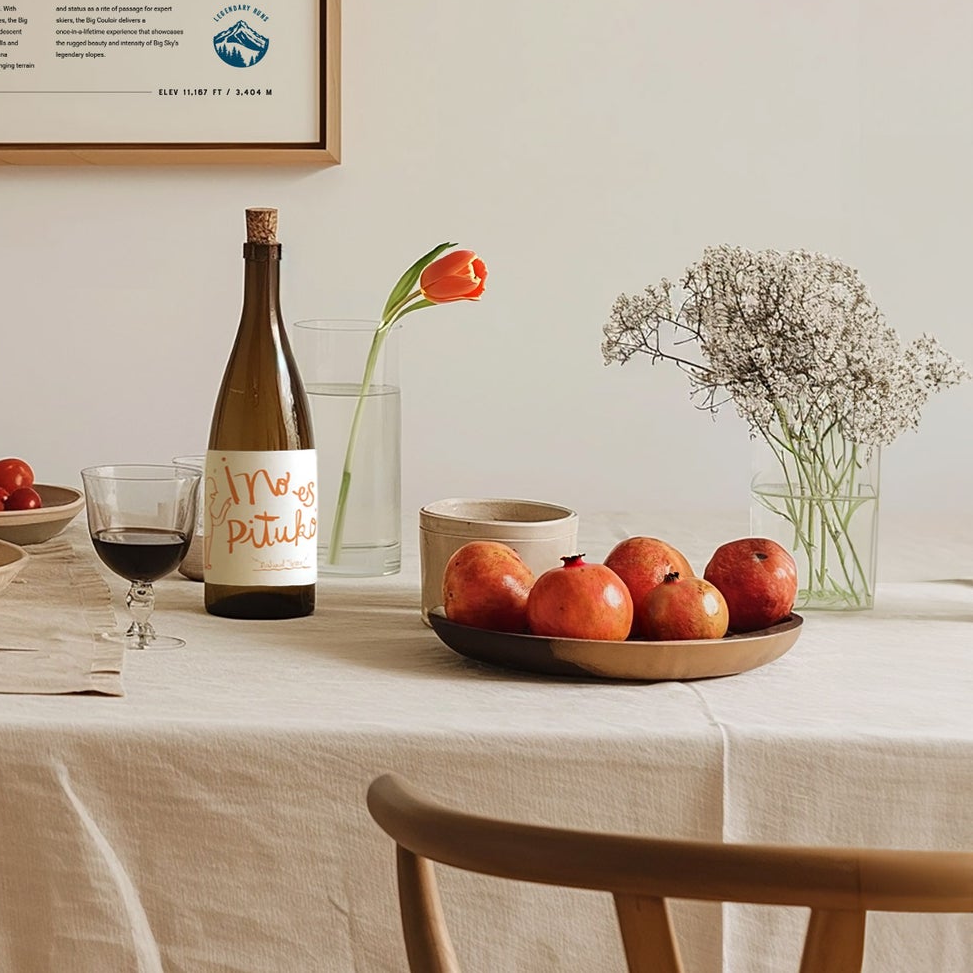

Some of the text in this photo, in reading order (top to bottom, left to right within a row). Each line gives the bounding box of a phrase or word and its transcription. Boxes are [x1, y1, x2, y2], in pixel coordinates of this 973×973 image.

[213, 4, 270, 22] LEGENDARY RUNS
[18, 16, 28, 25] Big
[85, 16, 96, 25] Big
[66, 40, 87, 48] rugged
[87, 39, 108, 48] beauty
[153, 39, 163, 48] Big
[164, 39, 179, 48] Sky's
[55, 51, 84, 59] legendary
